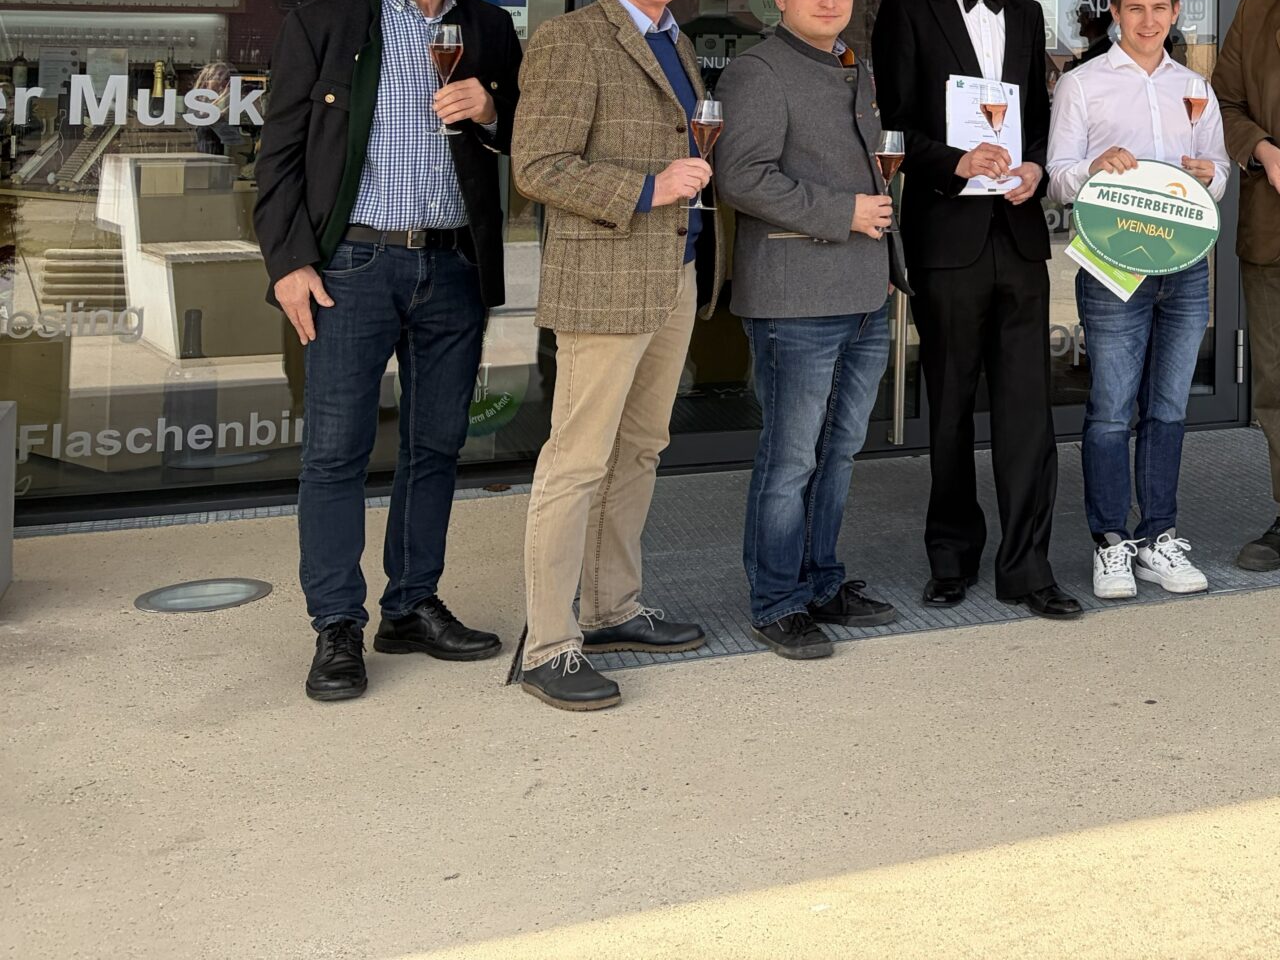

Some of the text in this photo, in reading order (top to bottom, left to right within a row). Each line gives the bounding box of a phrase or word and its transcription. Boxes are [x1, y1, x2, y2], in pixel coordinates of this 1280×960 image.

[69, 74, 266, 126] Musk
[1097, 188, 1204, 221] MEISTERBETRIEB
[1116, 217, 1174, 240] WEINBAU
